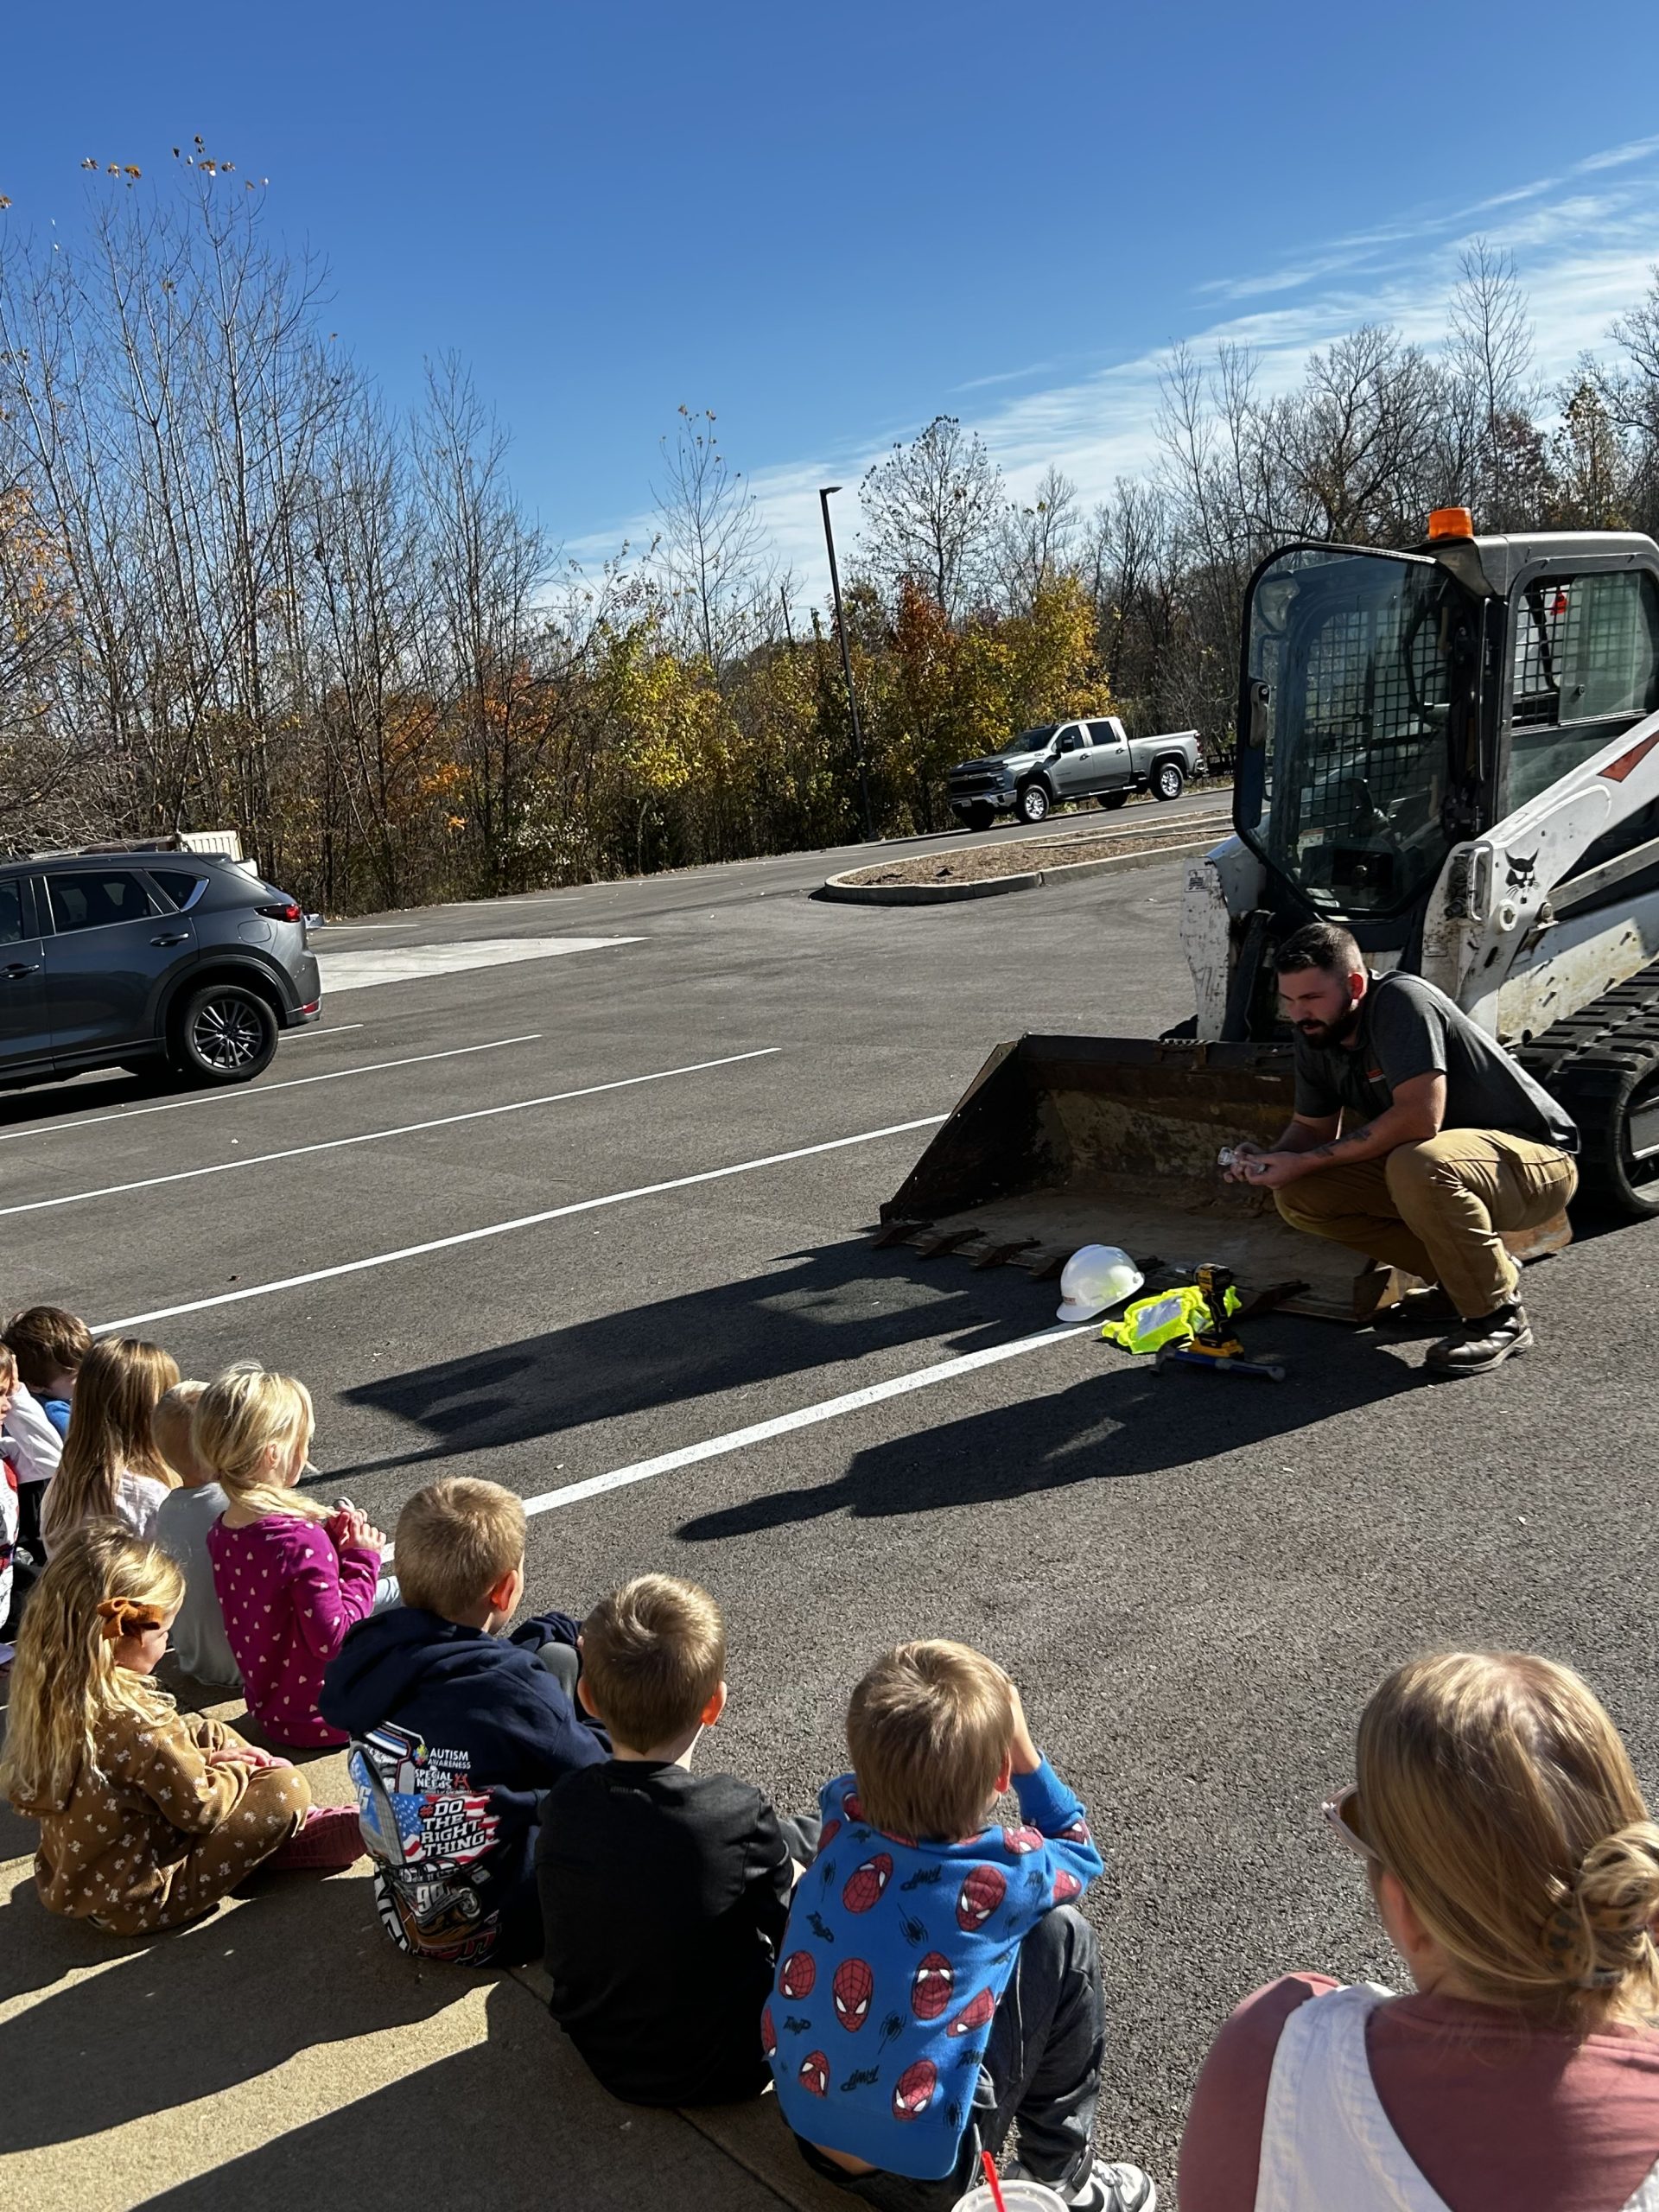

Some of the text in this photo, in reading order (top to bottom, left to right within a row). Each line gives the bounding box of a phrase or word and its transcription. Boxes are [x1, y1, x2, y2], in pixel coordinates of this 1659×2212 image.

[429, 1747, 468, 1761] AUTISM
[428, 1759, 471, 1770] AWARENESS
[415, 1768, 453, 1781] SPECIAL
[423, 1814, 464, 1830] THE
[421, 1820, 481, 1844] RIGHT
[424, 1831, 484, 1857] THING
